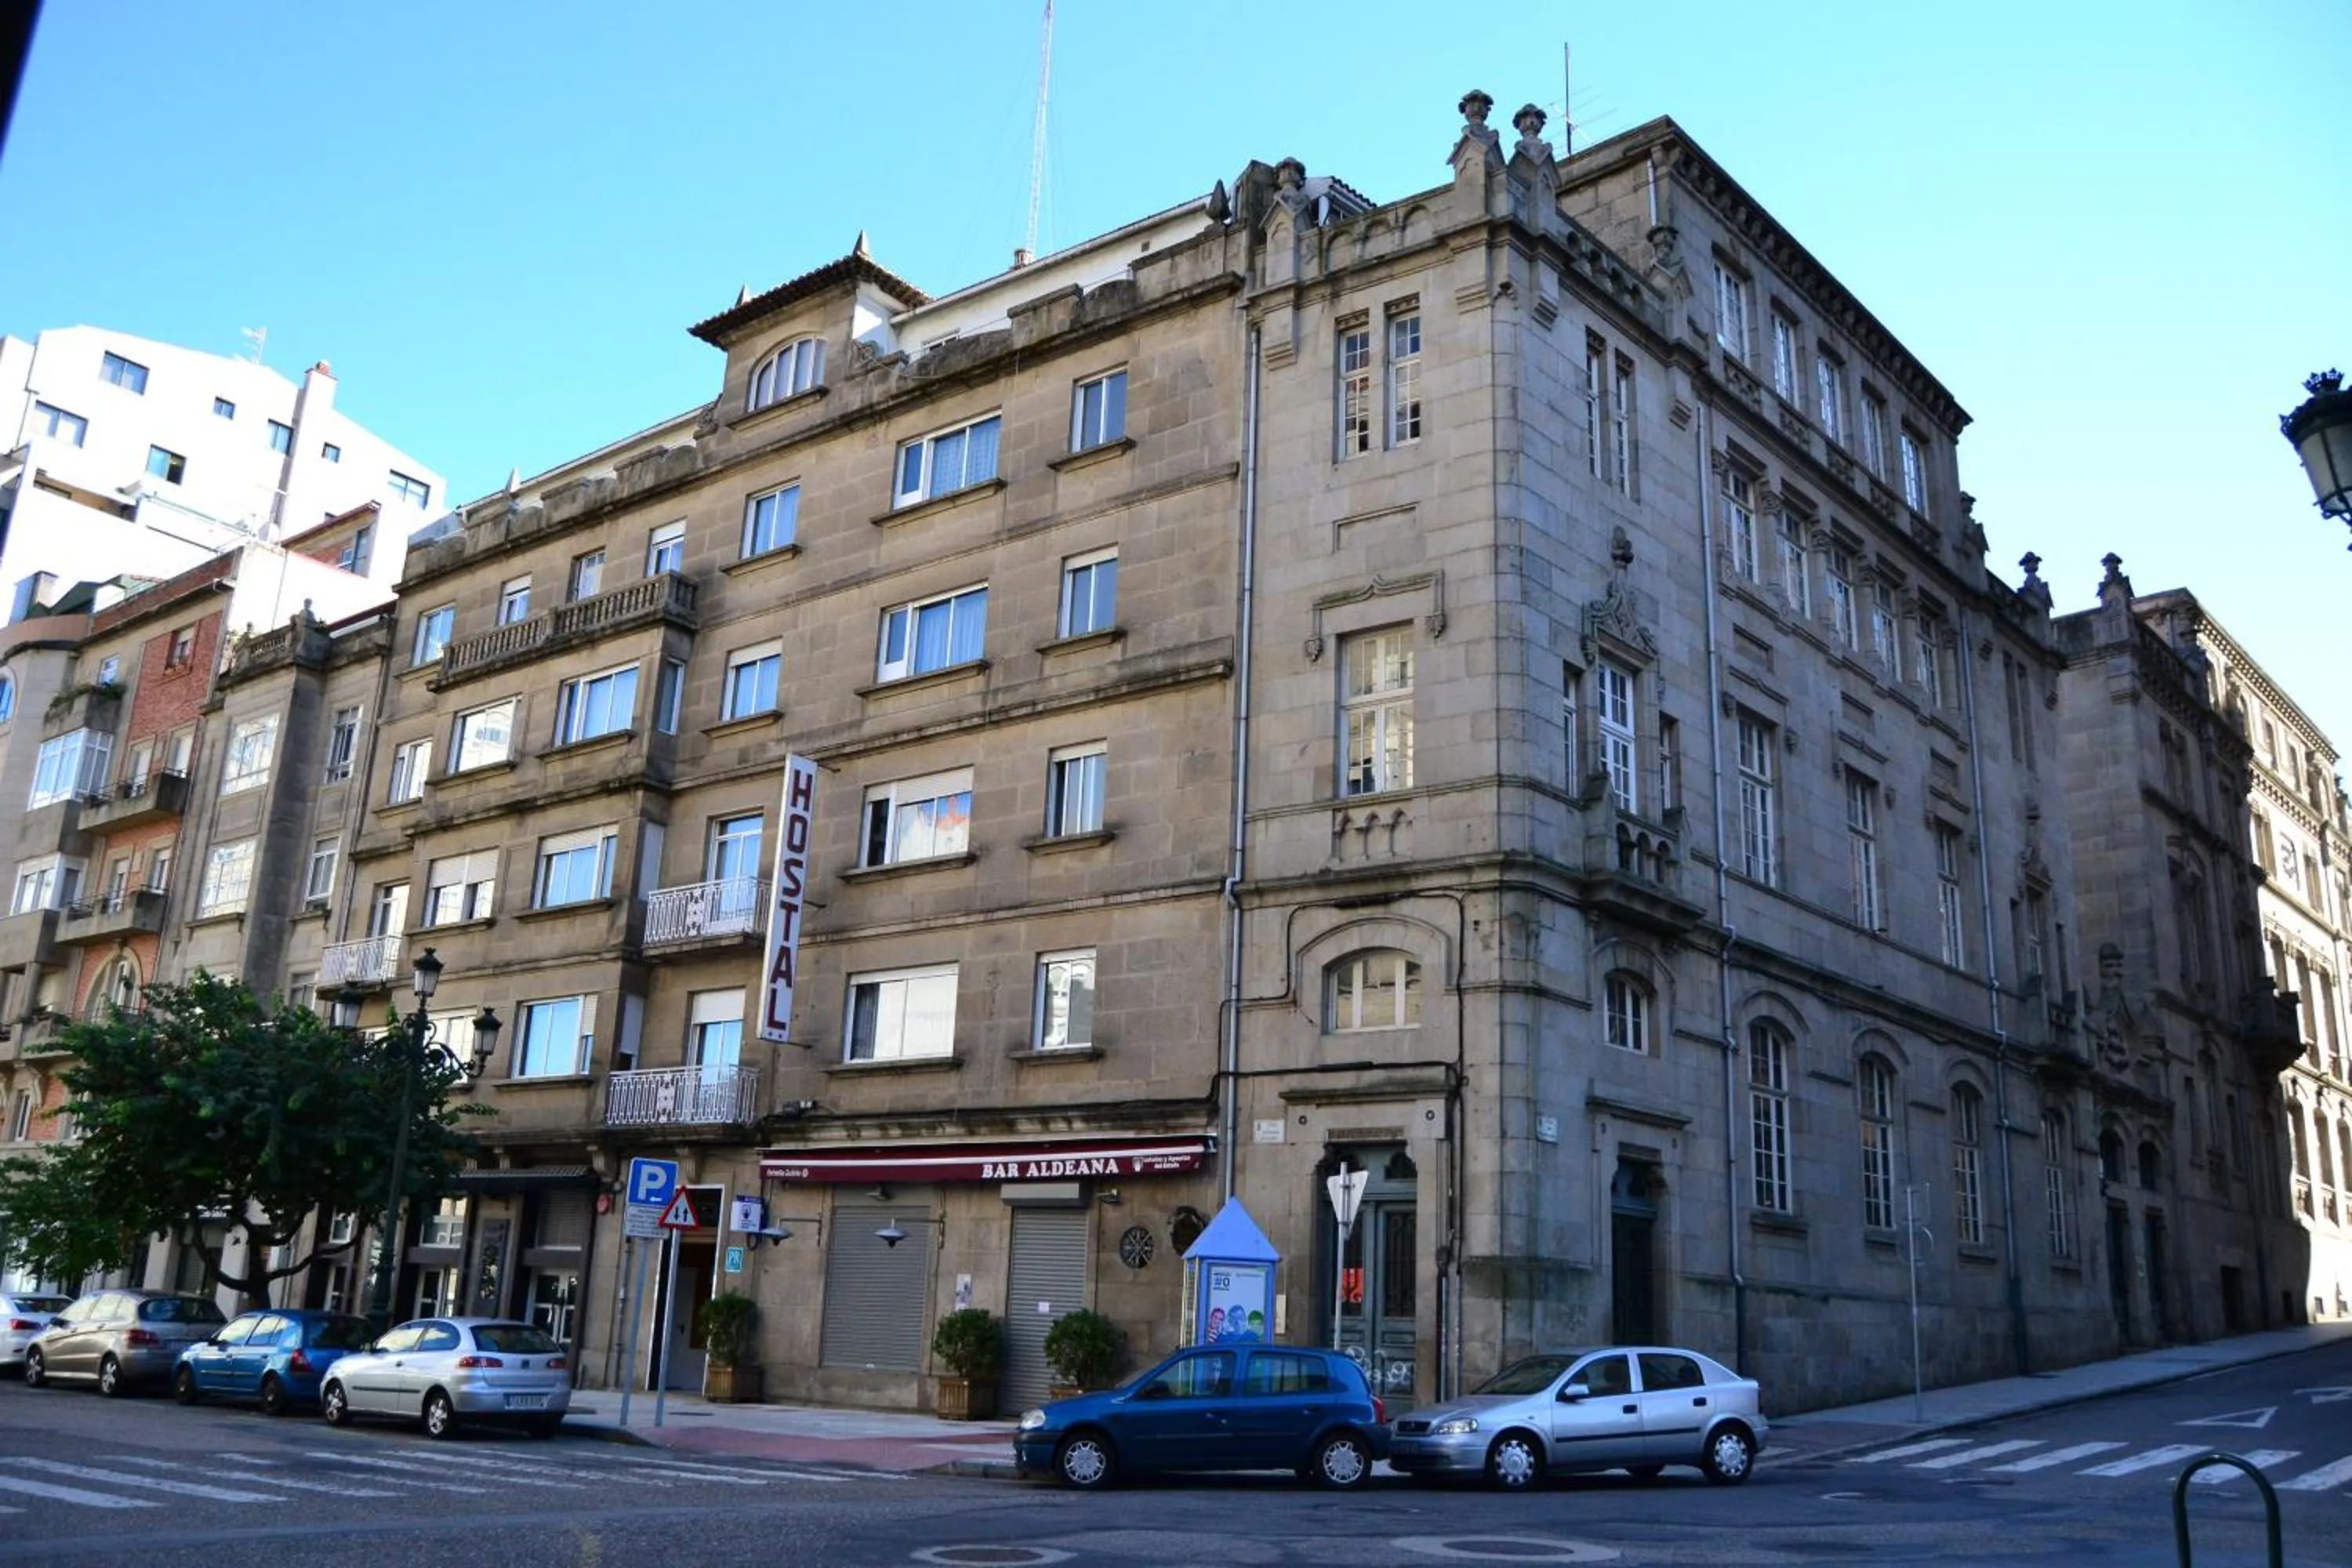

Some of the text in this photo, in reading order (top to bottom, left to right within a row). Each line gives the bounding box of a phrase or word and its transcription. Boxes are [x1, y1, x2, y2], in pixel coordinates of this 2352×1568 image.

[768, 769, 812, 1031] HOSTAL
[637, 1164, 667, 1200] P
[982, 1158, 1119, 1178] BAR ALDEANA
